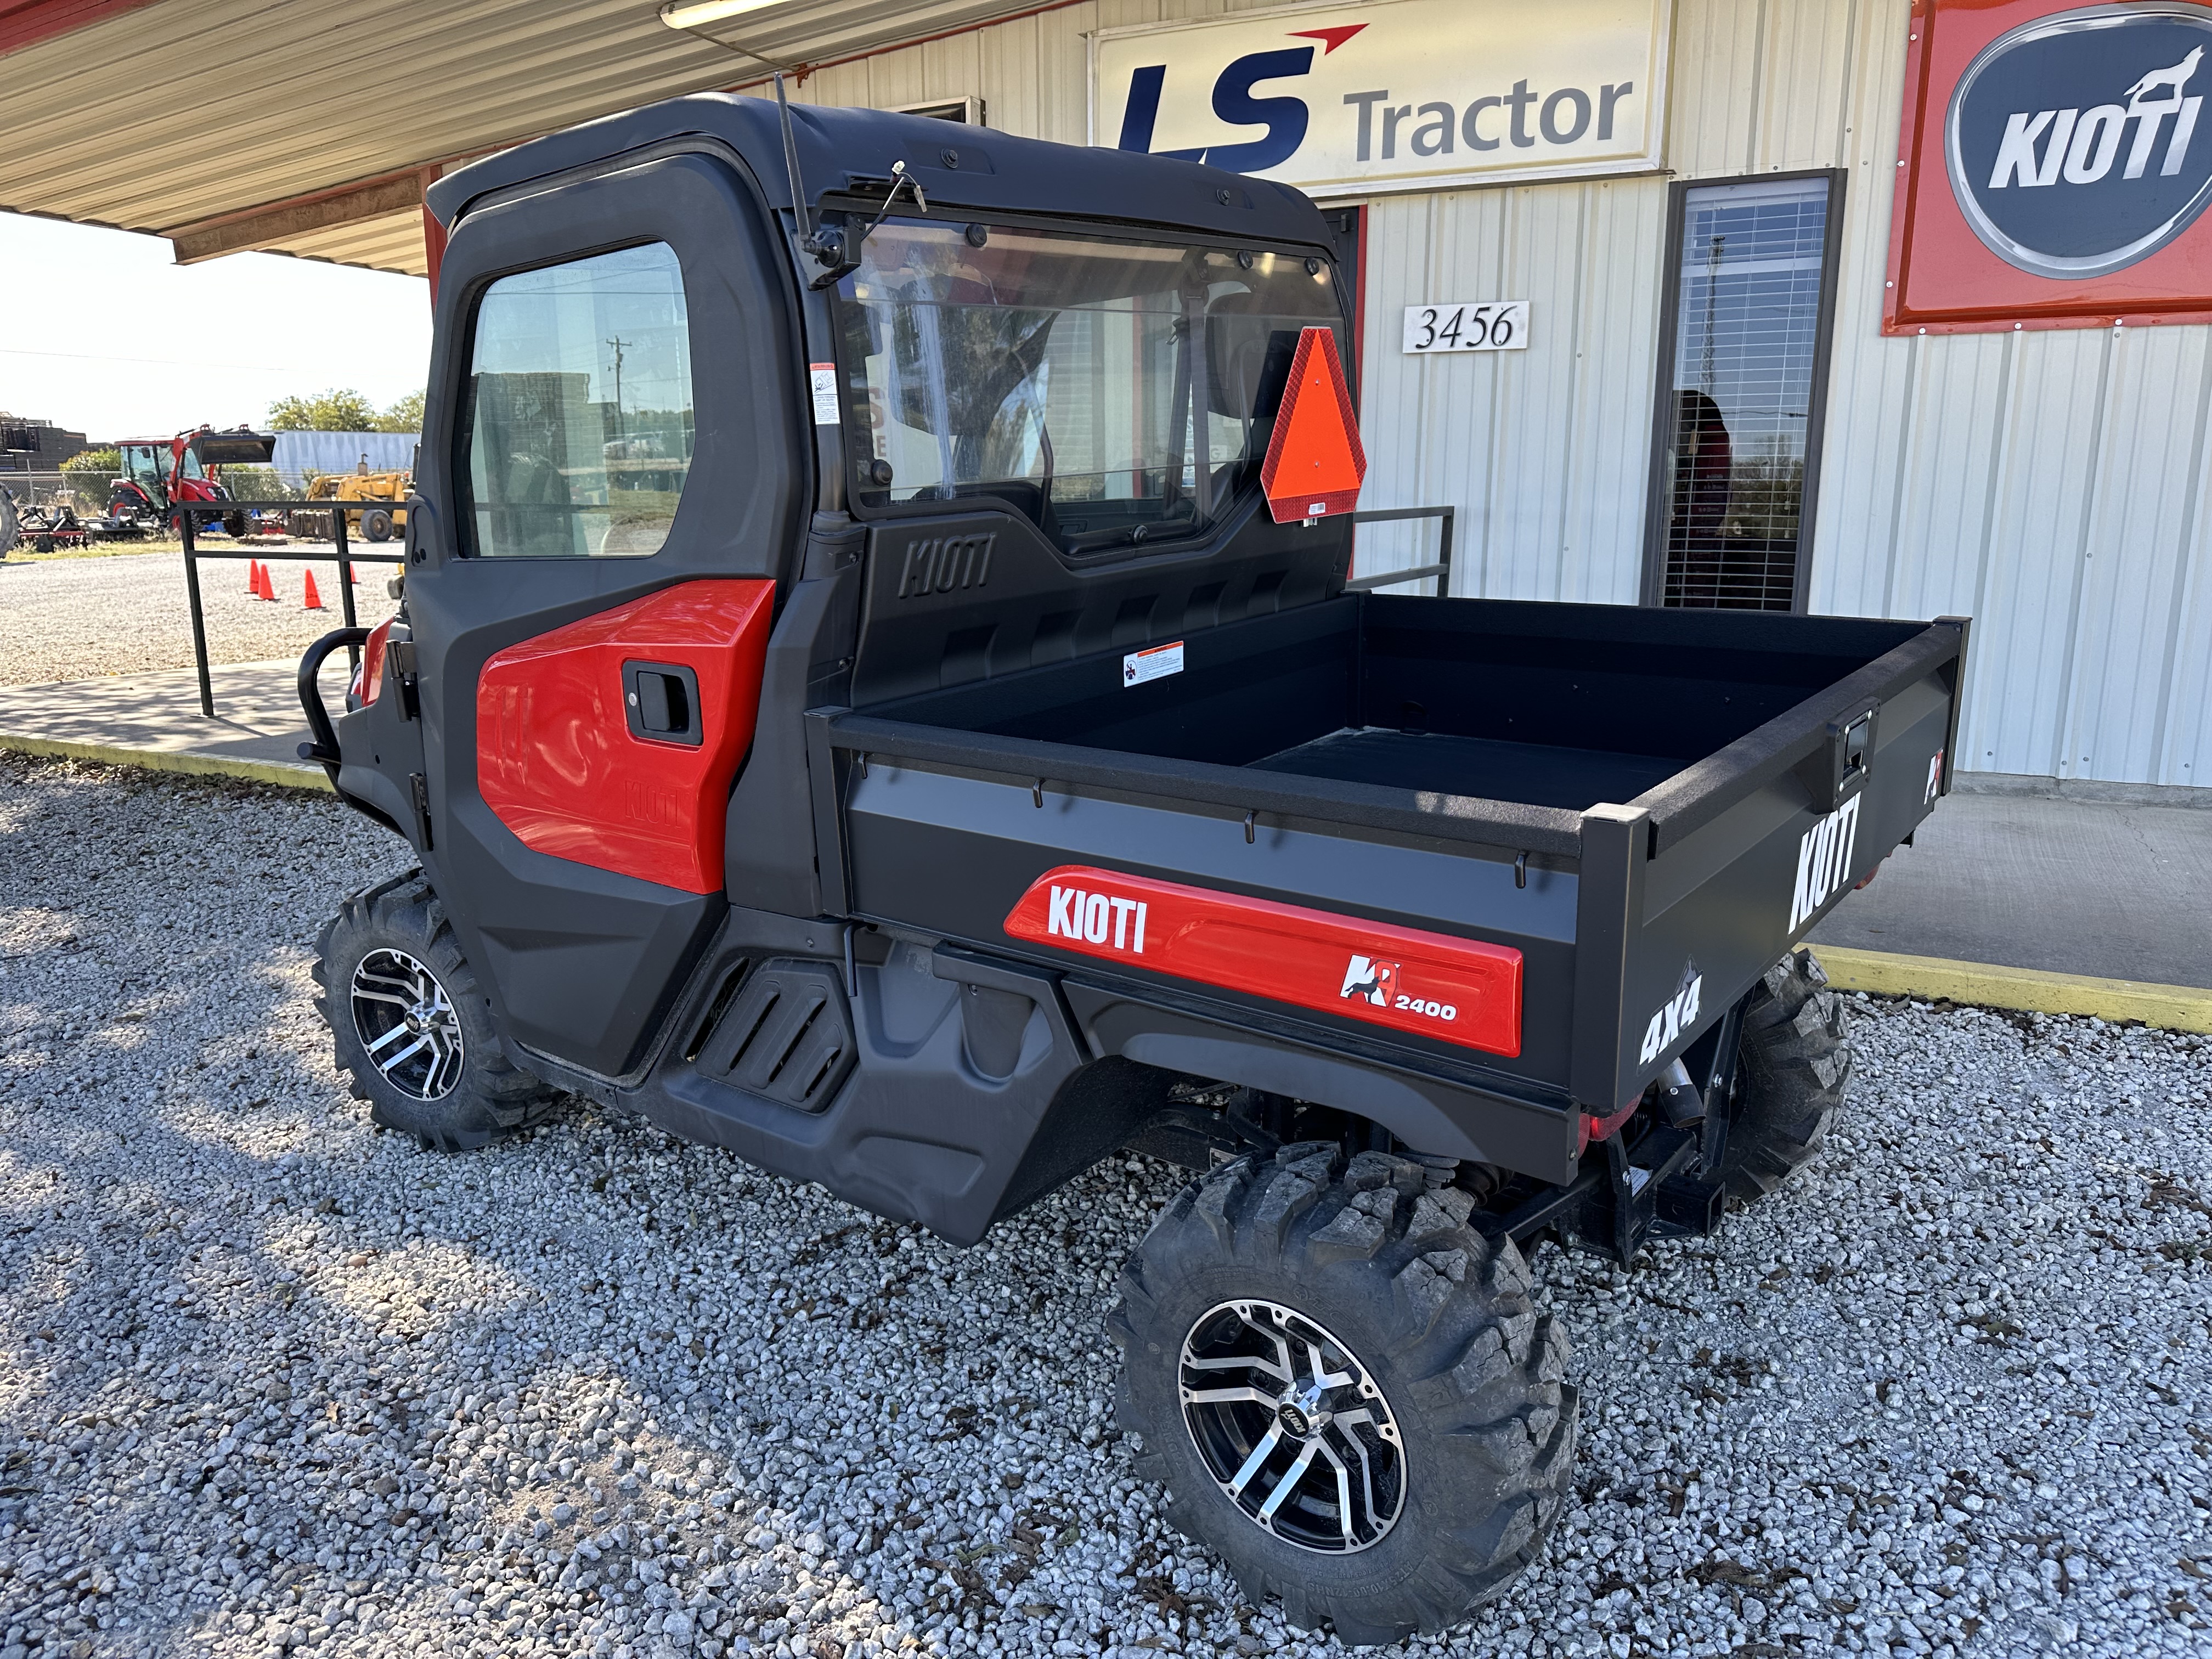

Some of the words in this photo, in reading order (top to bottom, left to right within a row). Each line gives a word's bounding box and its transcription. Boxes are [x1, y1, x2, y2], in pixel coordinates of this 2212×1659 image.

[1118, 46, 1314, 174] LS
[1342, 79, 1633, 162] Tractor
[1988, 96, 2203, 189] KIOTI
[1415, 305, 1517, 349] 3456
[898, 532, 997, 599] KIOTI
[624, 778, 682, 830] KIOTI
[1788, 791, 1861, 935] KIOTI
[1048, 885, 1148, 954] KIOTI
[1395, 995, 1457, 1021] 2400
[1284, 1408, 1306, 1433] KIOTI
